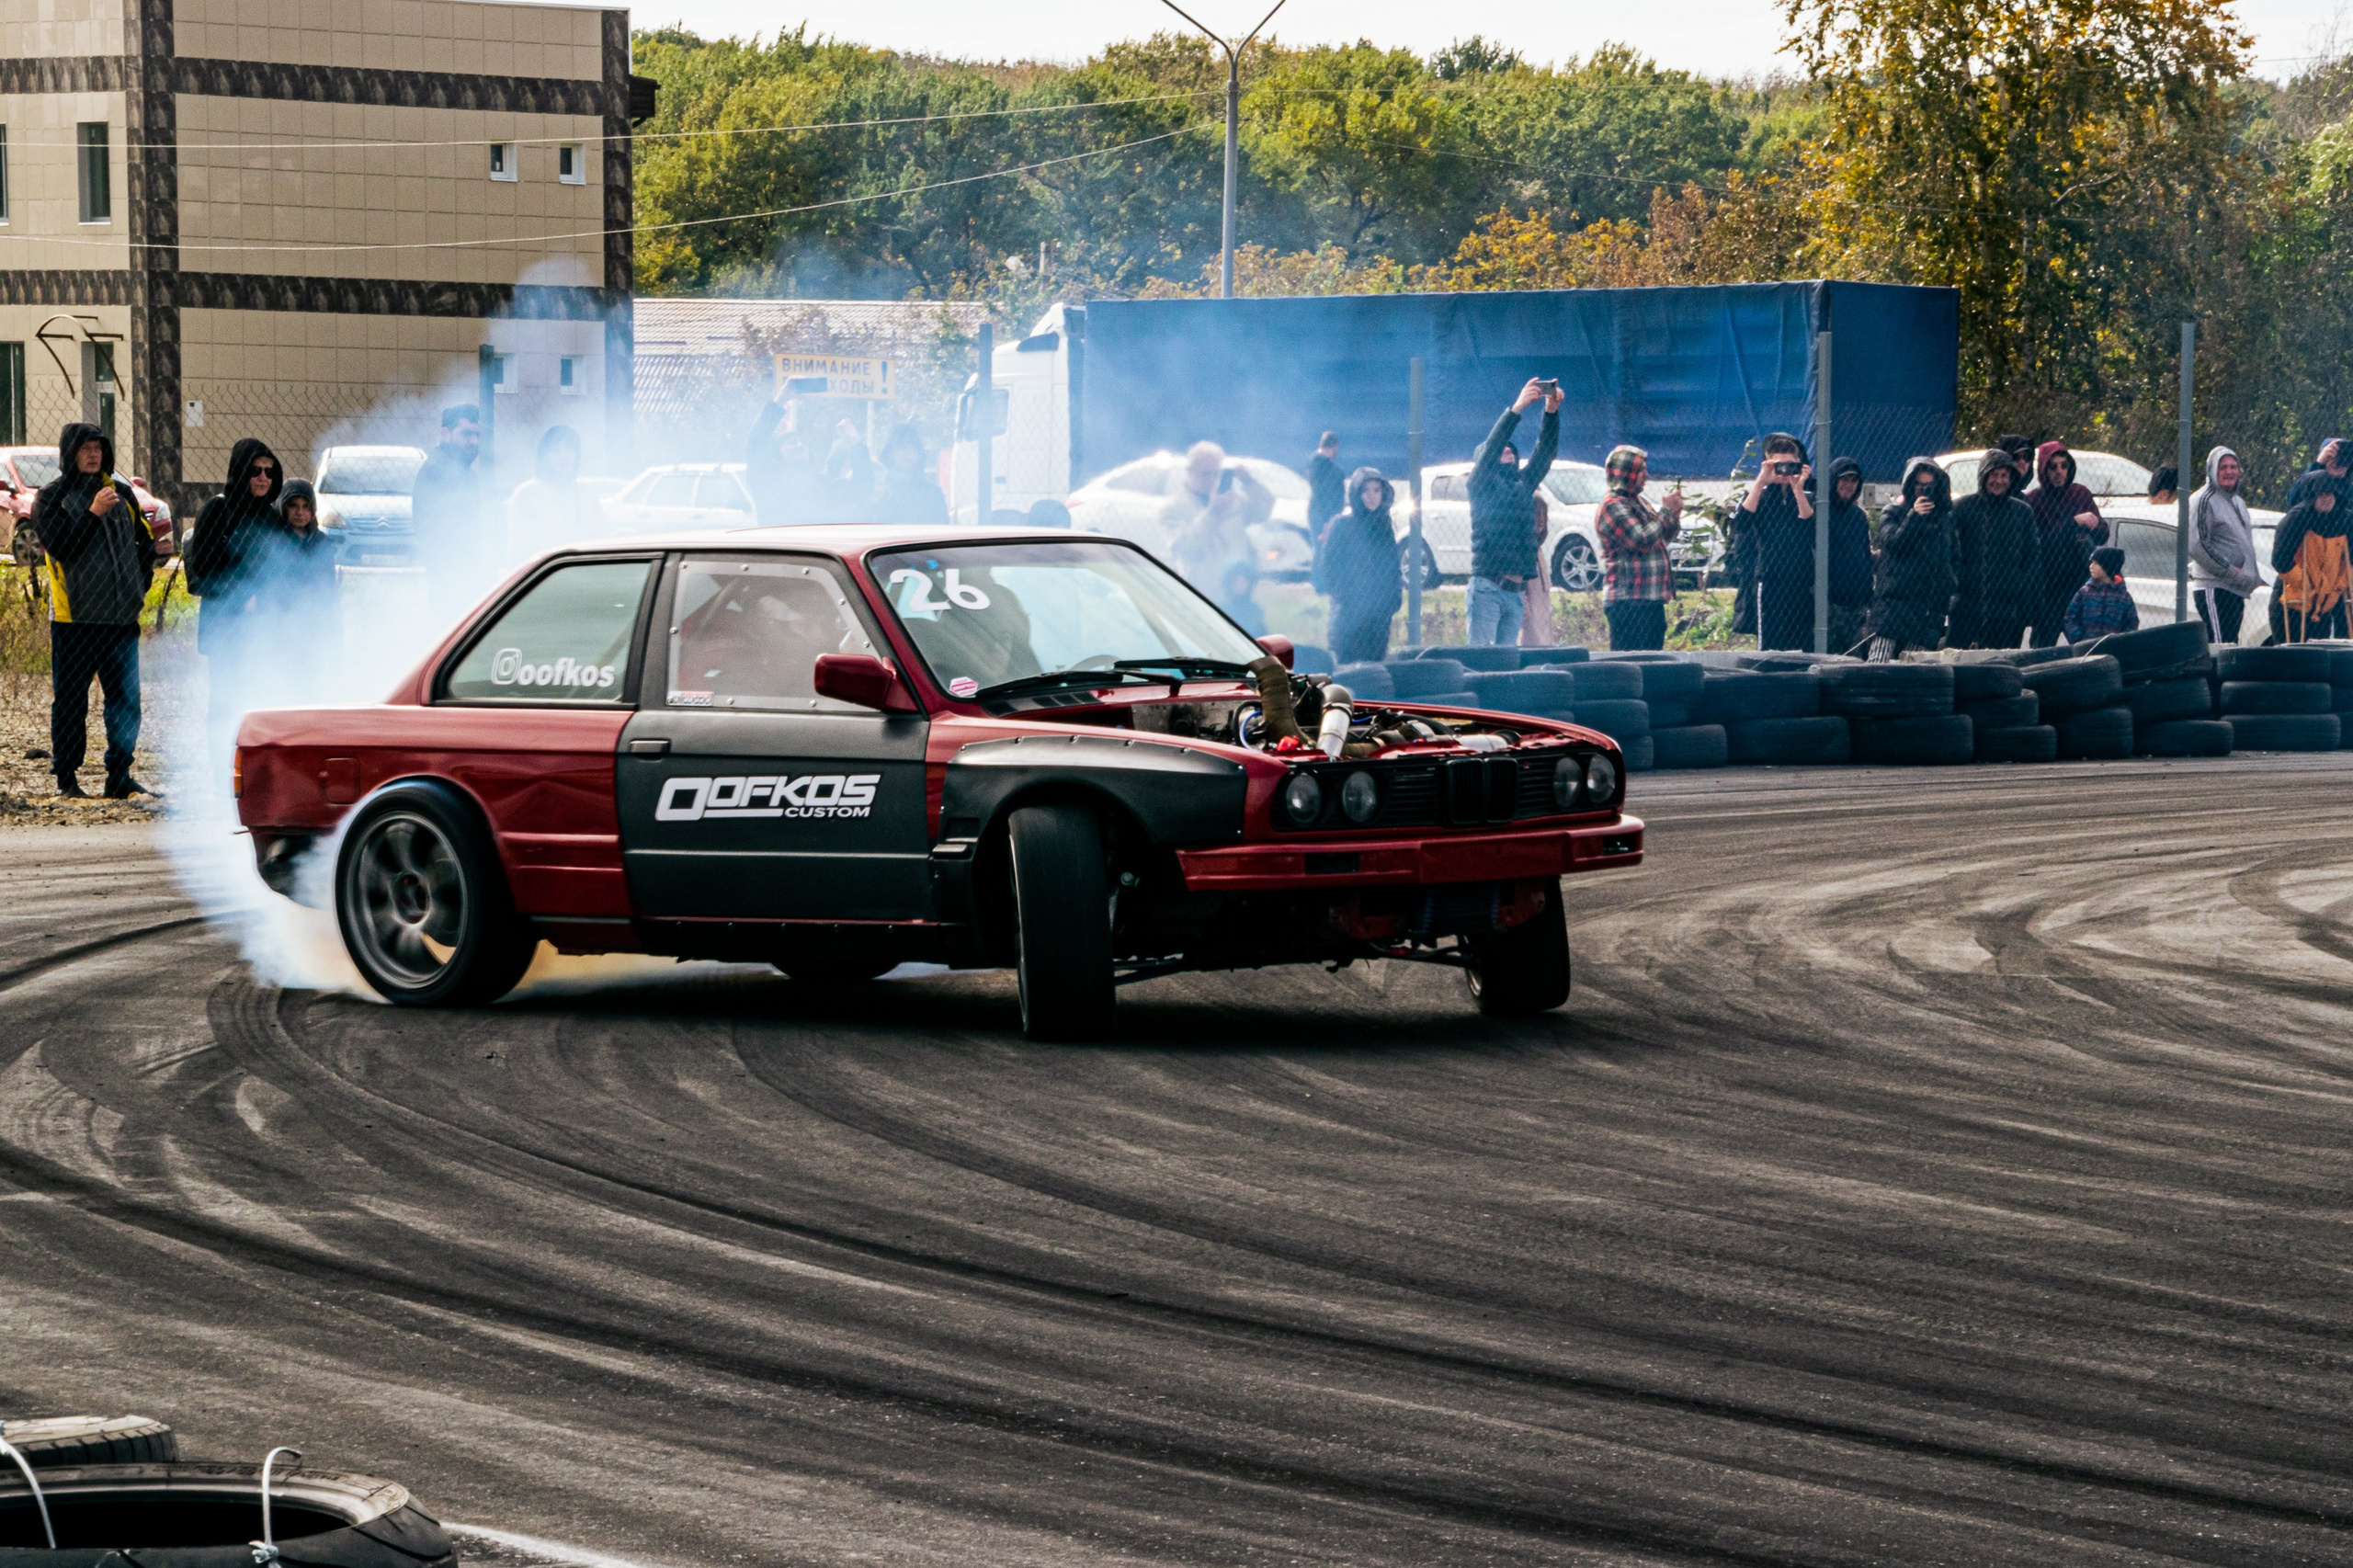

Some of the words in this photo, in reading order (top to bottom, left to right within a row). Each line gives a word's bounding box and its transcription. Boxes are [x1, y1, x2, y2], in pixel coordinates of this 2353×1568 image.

[782, 358, 871, 376] ВНИМАНИЕ
[889, 568, 991, 612] 26
[654, 774, 881, 822] OOFKOS
[785, 806, 871, 819] CUSTOM
